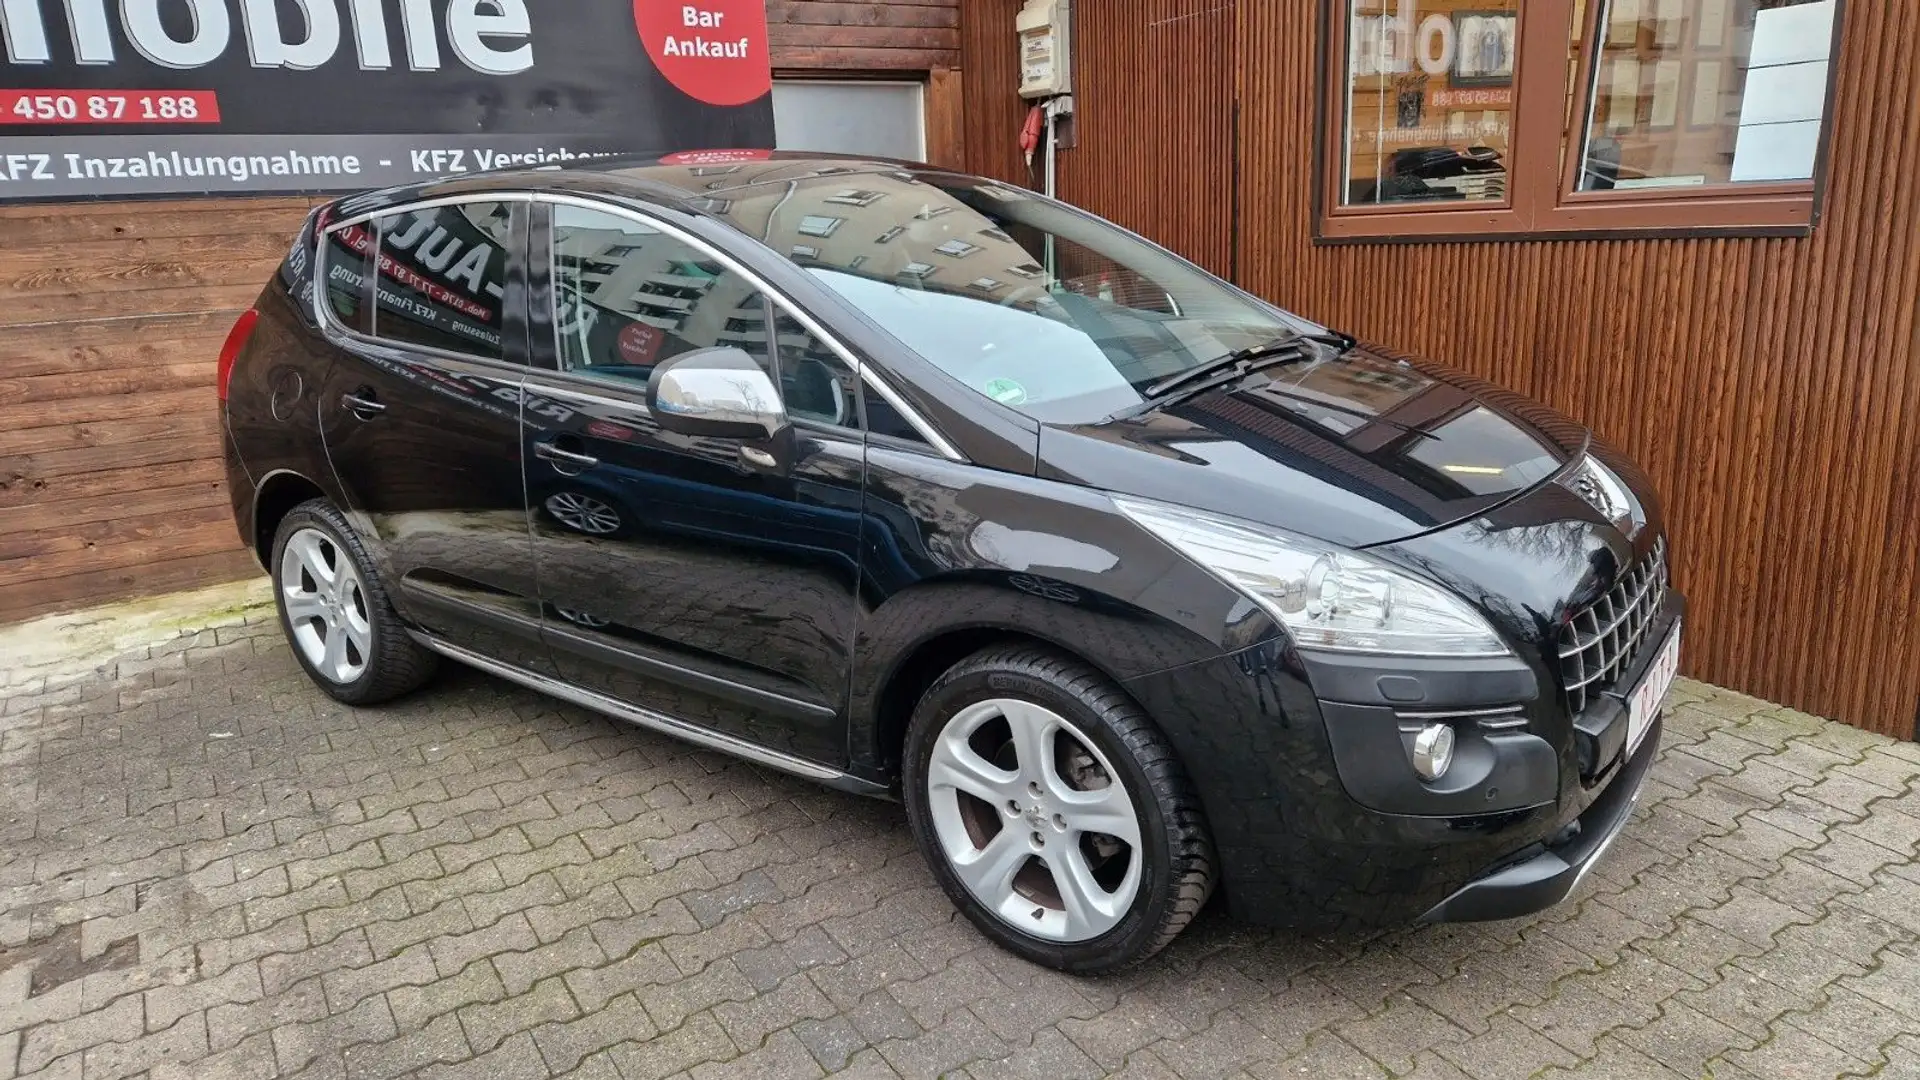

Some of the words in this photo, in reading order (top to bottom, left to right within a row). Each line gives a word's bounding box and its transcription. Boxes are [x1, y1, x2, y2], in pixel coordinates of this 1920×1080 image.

[682, 6, 724, 27] Bar
[663, 36, 748, 58] Ankauf
[13, 96, 77, 119] 450
[87, 96, 126, 119] 87
[140, 97, 199, 119] 188
[64, 150, 360, 182] Inzahlungnahme
[411, 150, 467, 172] KFZ
